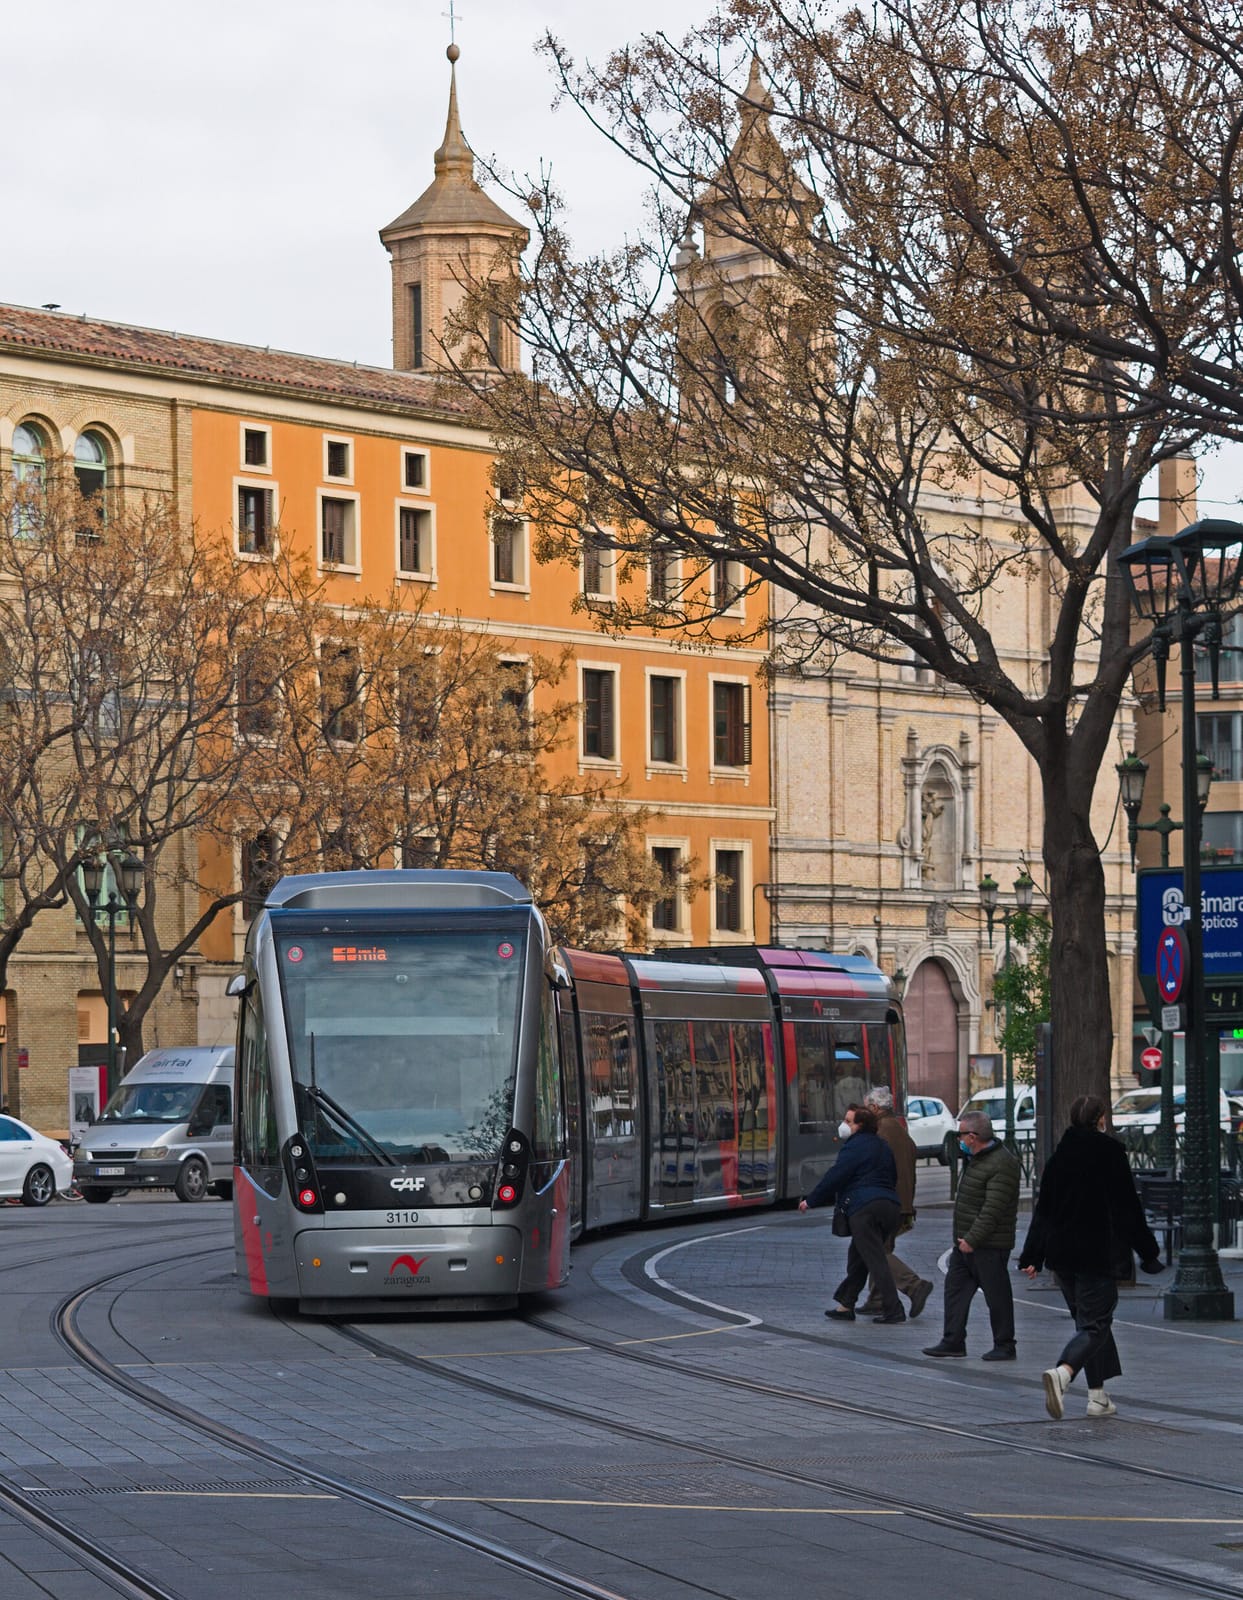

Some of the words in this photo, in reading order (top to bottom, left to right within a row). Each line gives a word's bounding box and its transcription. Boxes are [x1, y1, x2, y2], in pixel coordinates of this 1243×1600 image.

[1200, 890, 1243, 913] ámara
[152, 1058, 192, 1068] airfal
[390, 1177, 426, 1192] CAF
[386, 1211, 419, 1224] 3110
[384, 1275, 431, 1288] zaragoza
